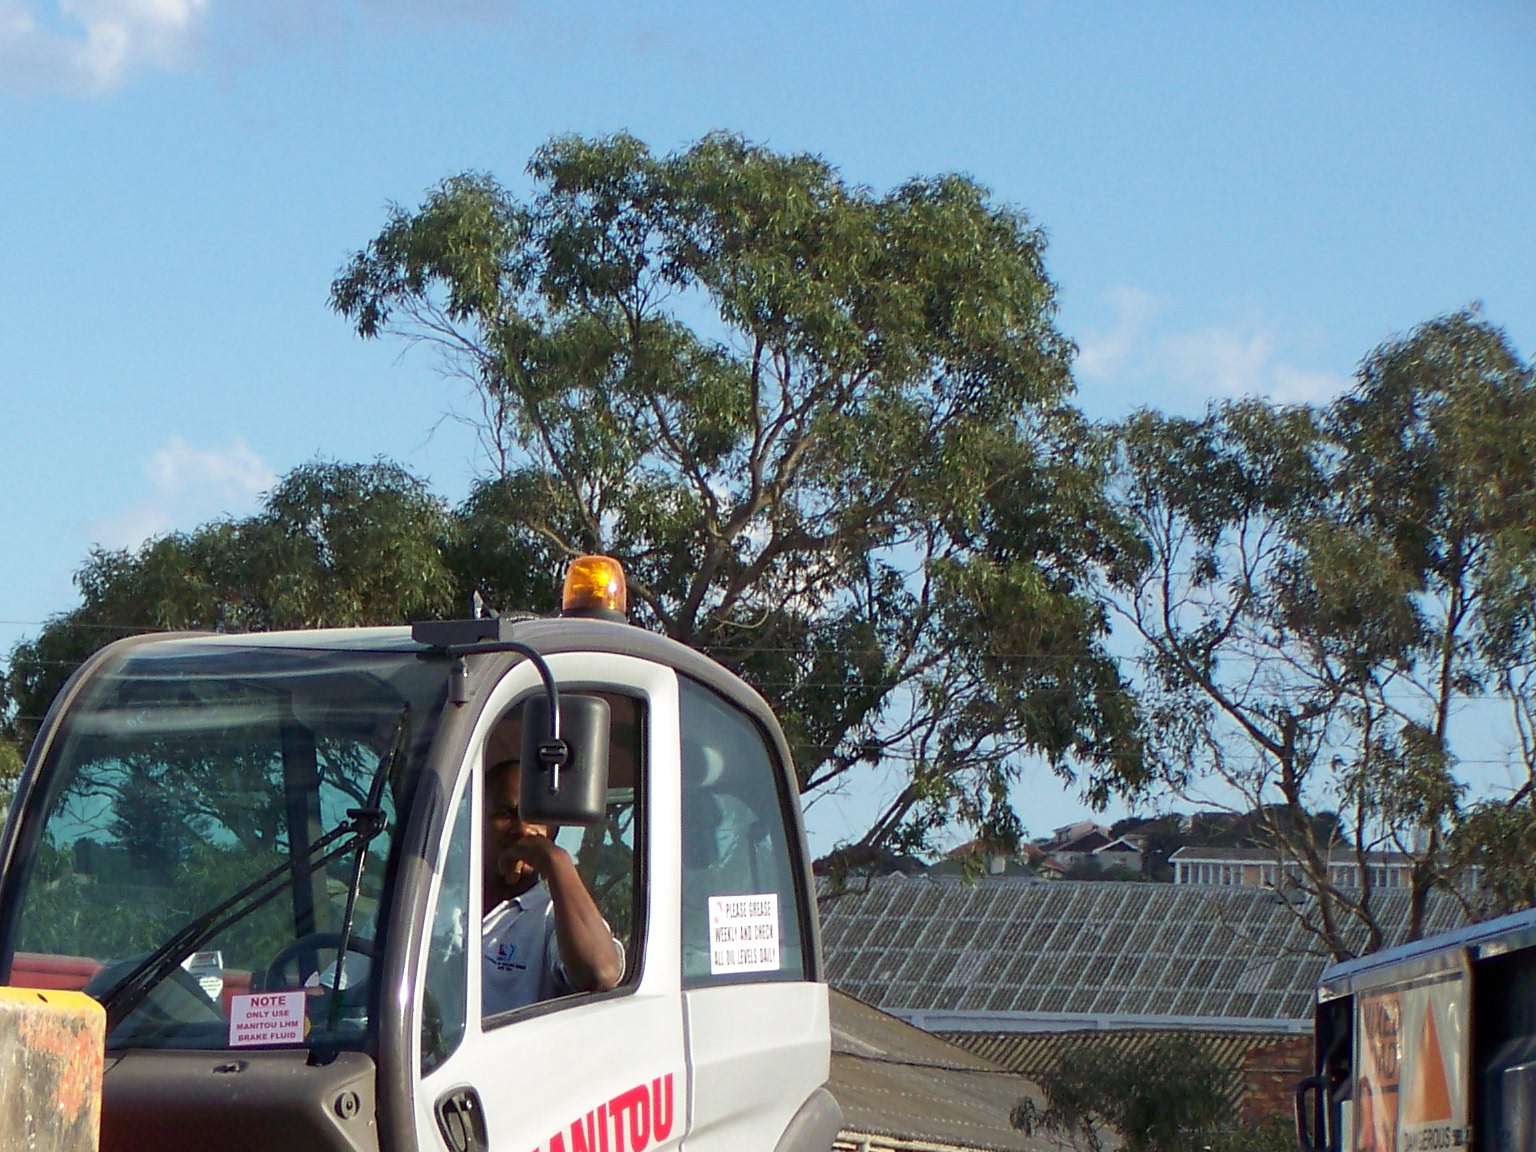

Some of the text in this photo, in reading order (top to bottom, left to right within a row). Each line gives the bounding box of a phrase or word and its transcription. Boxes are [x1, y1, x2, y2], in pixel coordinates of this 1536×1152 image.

[726, 901, 771, 918] PLEASE GREASE
[714, 924, 773, 942] WEEKLY AND CHECK
[714, 950, 725, 966] ALL
[737, 948, 757, 964] LEVELS
[759, 947, 775, 963] DAILY
[250, 996, 286, 1007] NOTE
[246, 1011, 269, 1019] ONLY
[236, 1020, 298, 1030] MANITOU LHM
[238, 1032, 296, 1042] BRAKE FLUID
